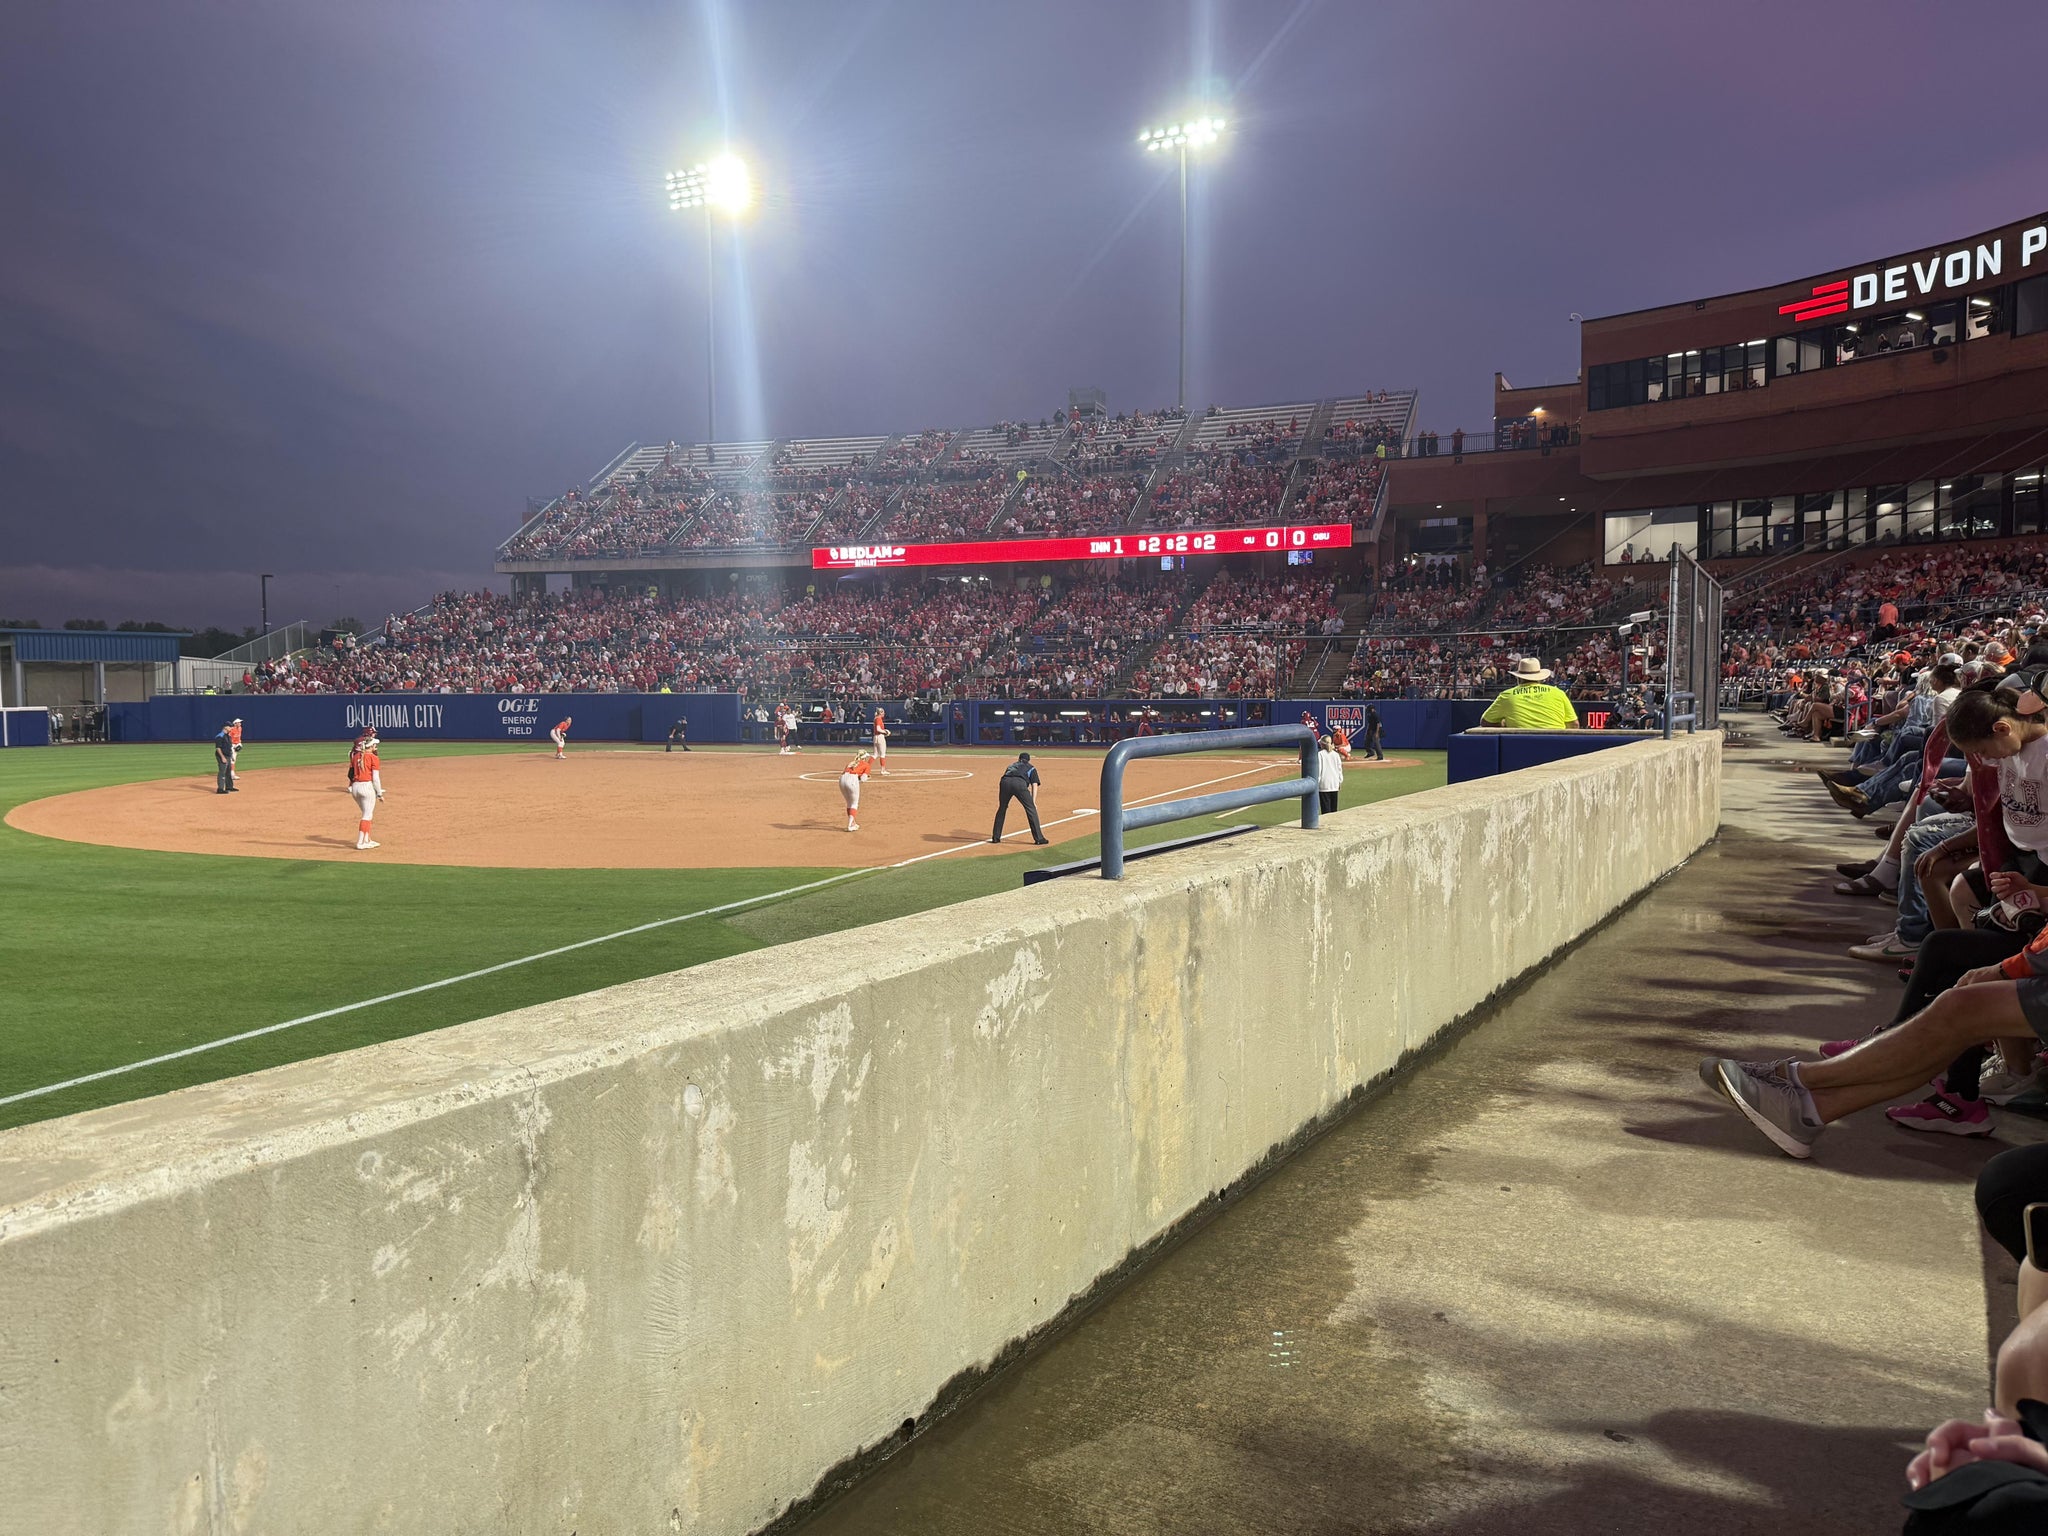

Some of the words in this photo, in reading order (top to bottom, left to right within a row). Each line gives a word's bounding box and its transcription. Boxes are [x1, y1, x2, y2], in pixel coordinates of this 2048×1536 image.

[1853, 239, 2001, 309] DEVON
[1090, 541, 1111, 553] INN
[1114, 538, 1124, 554] 1
[1243, 536, 1255, 544] OU
[1266, 531, 1278, 547] 0
[1292, 530, 1305, 546] 0
[840, 546, 892, 560] BEDLAM
[1513, 686, 1532, 696] EVENT
[345, 698, 409, 728] OKLAHOMA
[414, 704, 443, 728] CITY
[1328, 707, 1363, 720] USA
[502, 716, 537, 725] ENERGY
[508, 726, 532, 735] FIELD
[1936, 1101, 1957, 1115] NIKE
